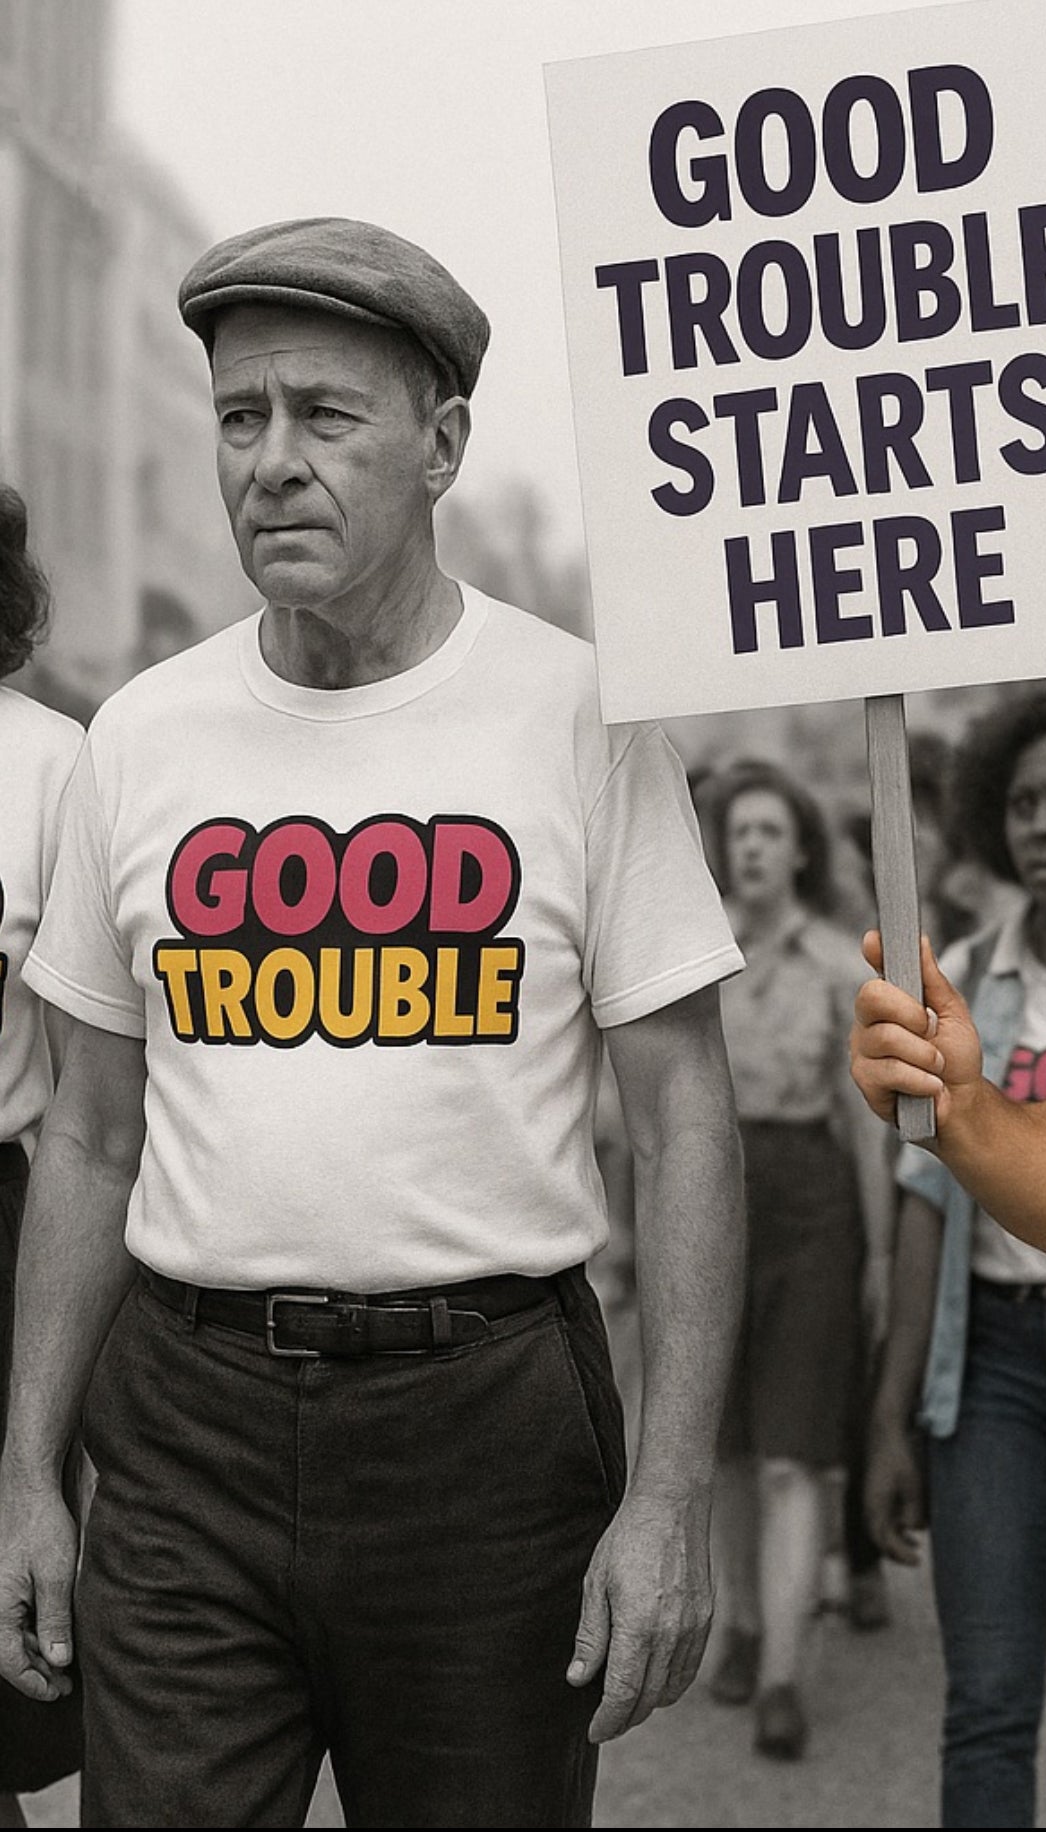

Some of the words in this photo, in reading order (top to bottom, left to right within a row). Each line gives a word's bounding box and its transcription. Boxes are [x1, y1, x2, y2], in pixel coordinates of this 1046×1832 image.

[648, 64, 994, 229] GOOD
[723, 505, 1016, 655] HERE
[170, 821, 513, 937] GOOD
[156, 946, 519, 1040] TROUBLE
